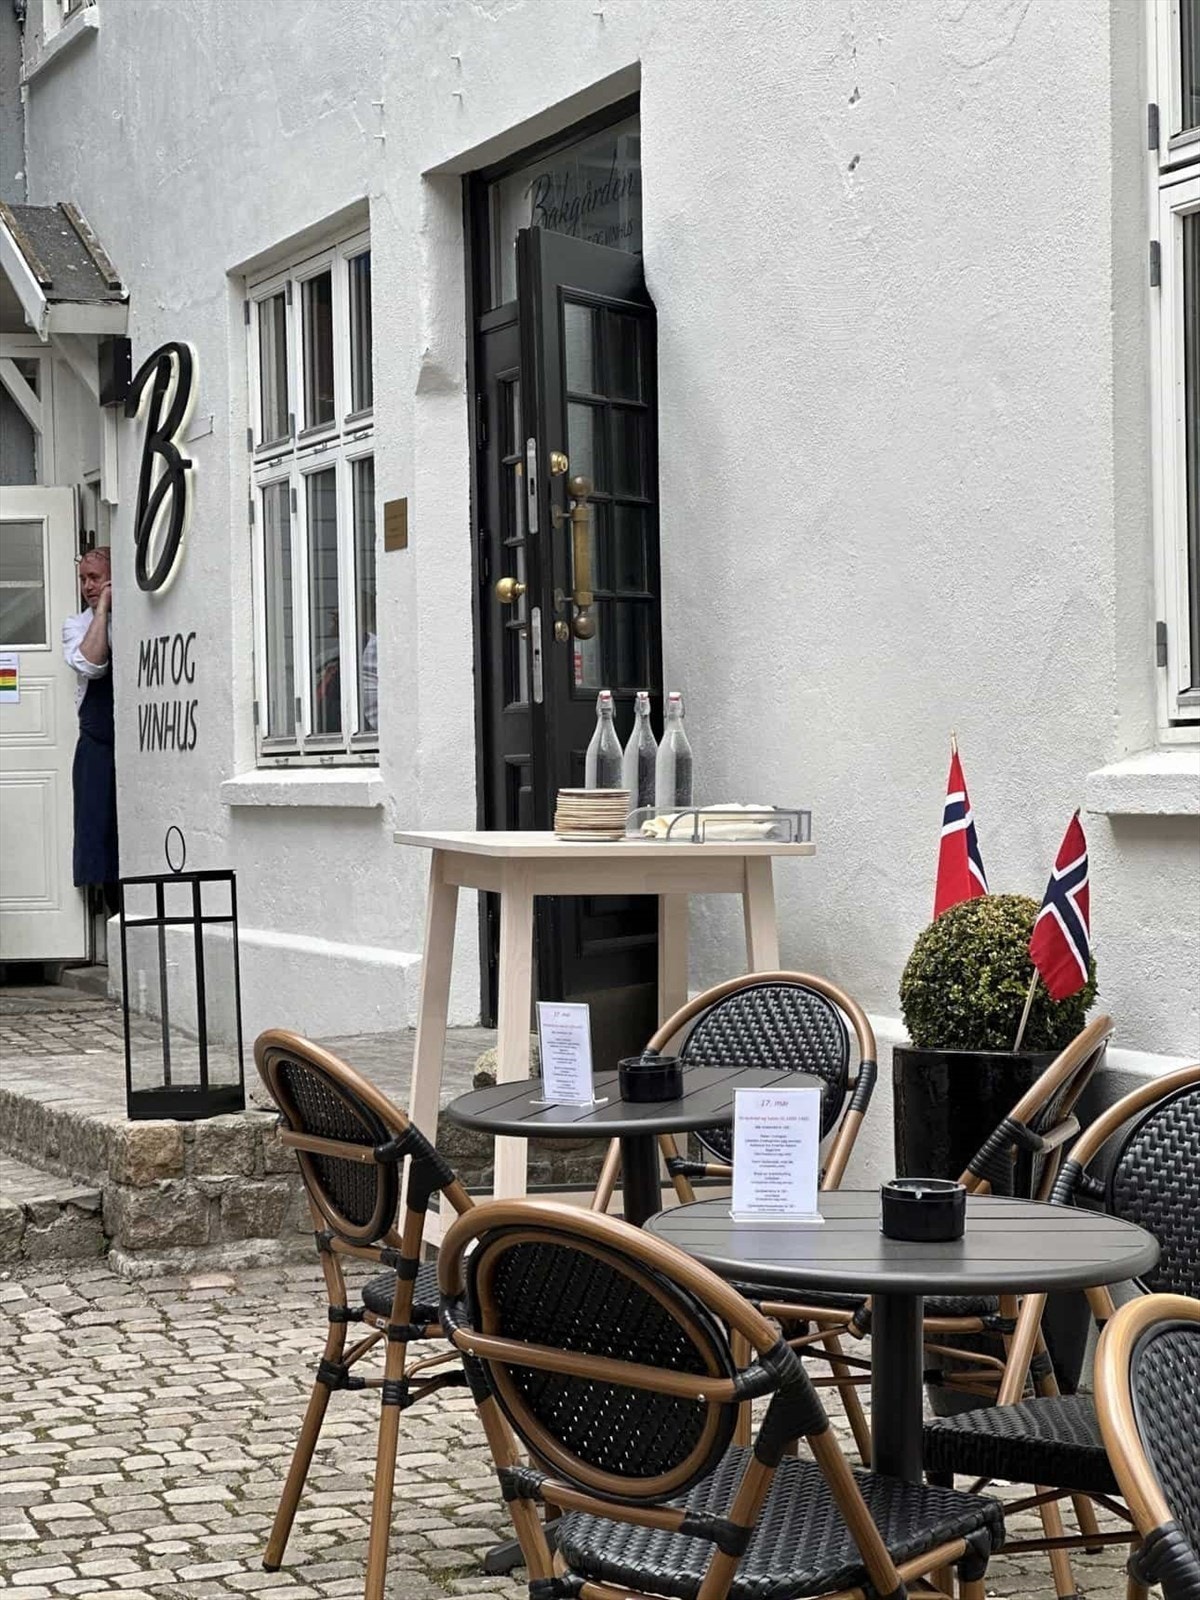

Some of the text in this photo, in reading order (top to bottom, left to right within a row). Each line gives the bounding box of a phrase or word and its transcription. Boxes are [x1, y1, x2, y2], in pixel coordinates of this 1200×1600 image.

[524, 148, 633, 237] Bakgården
[125, 341, 193, 592] B
[137, 632, 196, 688] MAT OG
[138, 699, 198, 752] VINHUS
